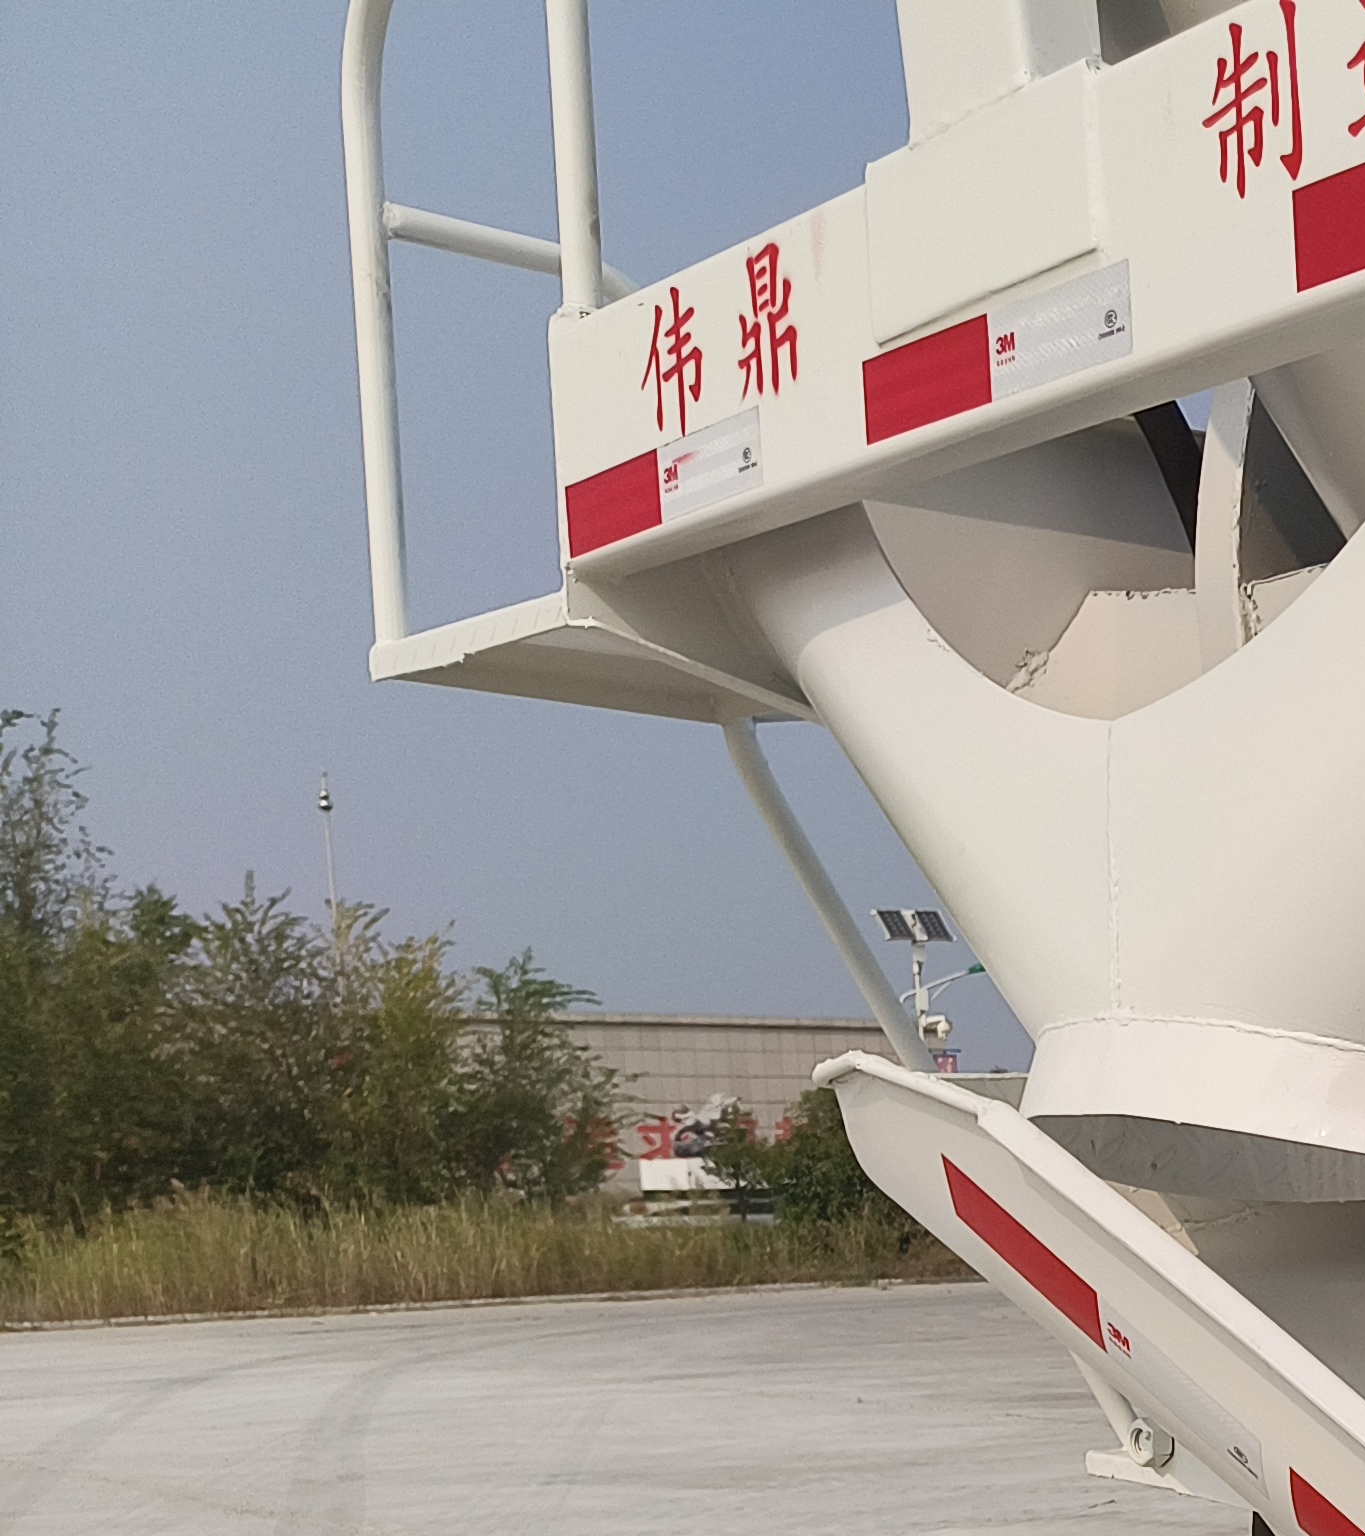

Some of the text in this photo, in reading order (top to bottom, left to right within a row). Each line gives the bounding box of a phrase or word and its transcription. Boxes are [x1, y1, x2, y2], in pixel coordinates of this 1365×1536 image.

[641, 243, 798, 436] 伟鼎
[996, 332, 1015, 355] 3M
[664, 464, 678, 484] 3M
[1107, 1321, 1131, 1352] 3M
